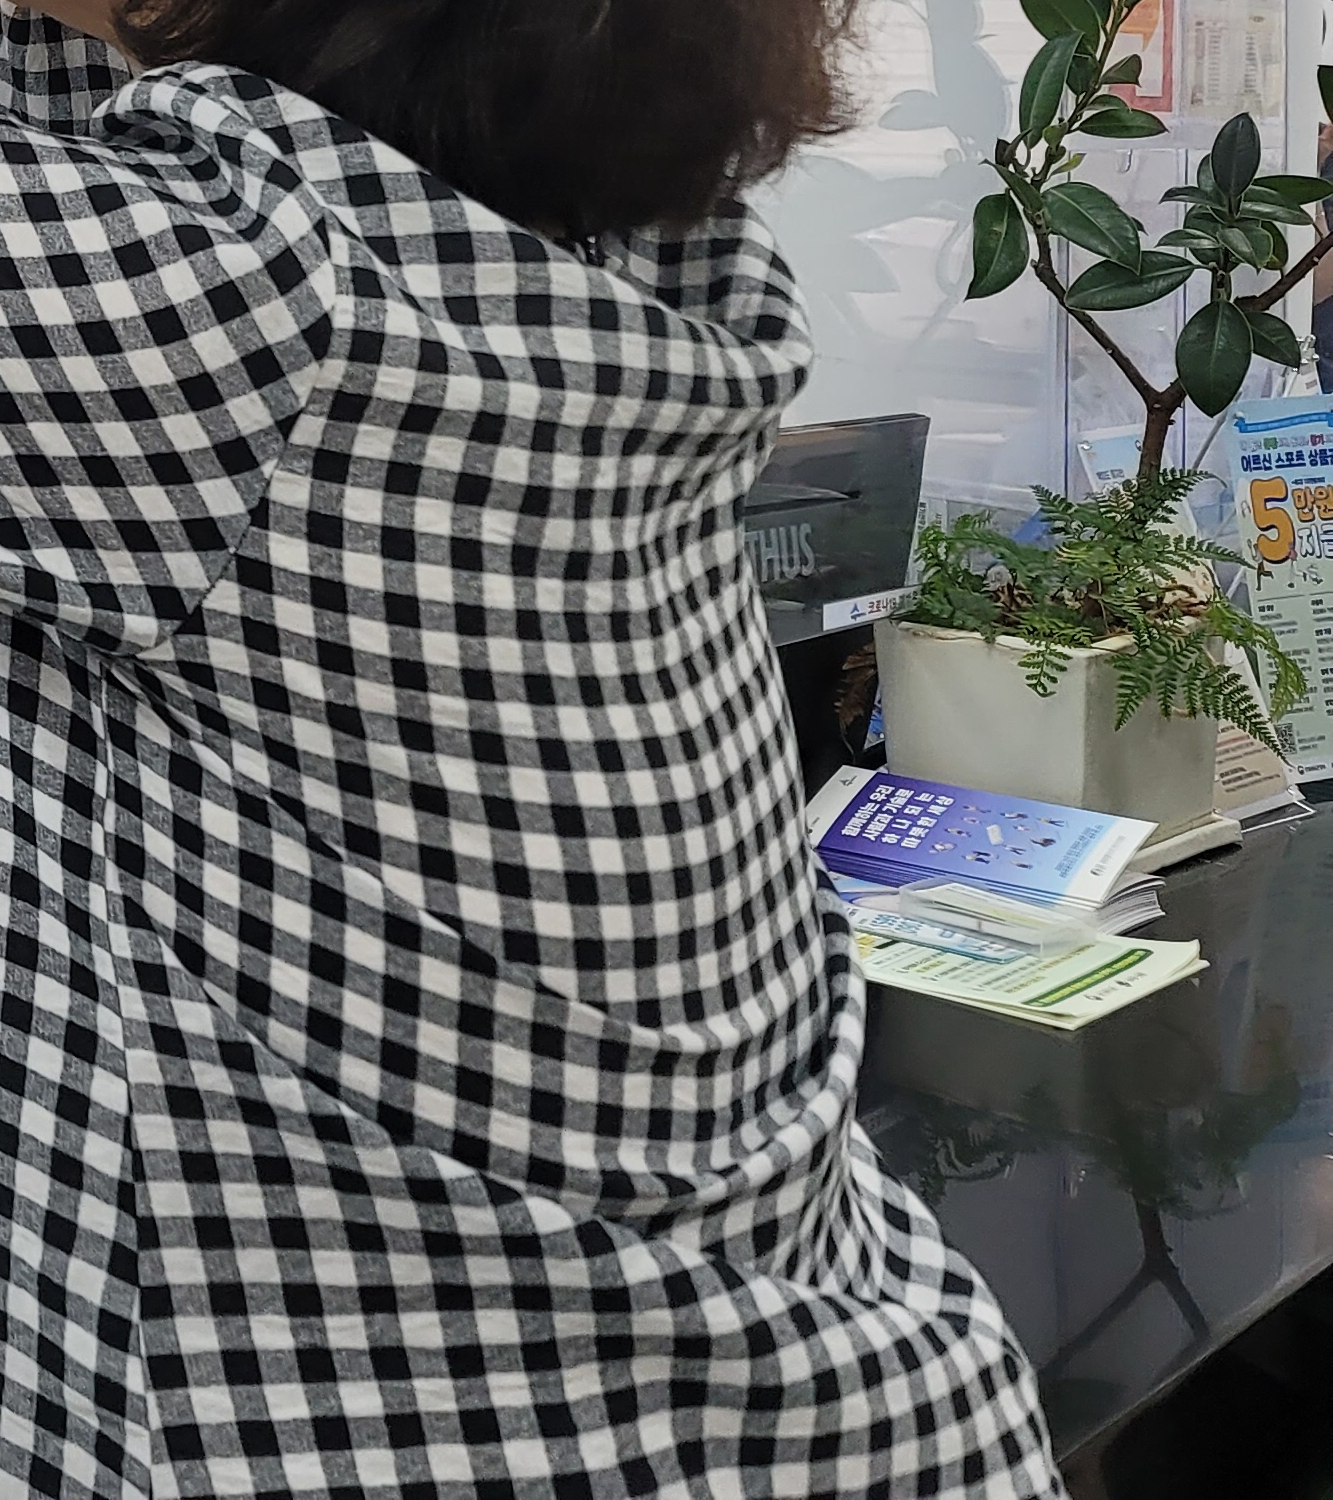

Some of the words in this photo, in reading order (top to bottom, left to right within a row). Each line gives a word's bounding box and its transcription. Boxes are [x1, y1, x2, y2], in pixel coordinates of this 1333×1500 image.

[1241, 452, 1273, 472] 어르신
[1275, 450, 1306, 468] 스포츠
[1250, 476, 1295, 565] 5
[744, 522, 816, 582] THUS
[841, 802, 880, 837] 함께하는
[869, 785, 895, 802] 우리
[927, 795, 955, 816] 세상
[862, 814, 893, 841] 사람과
